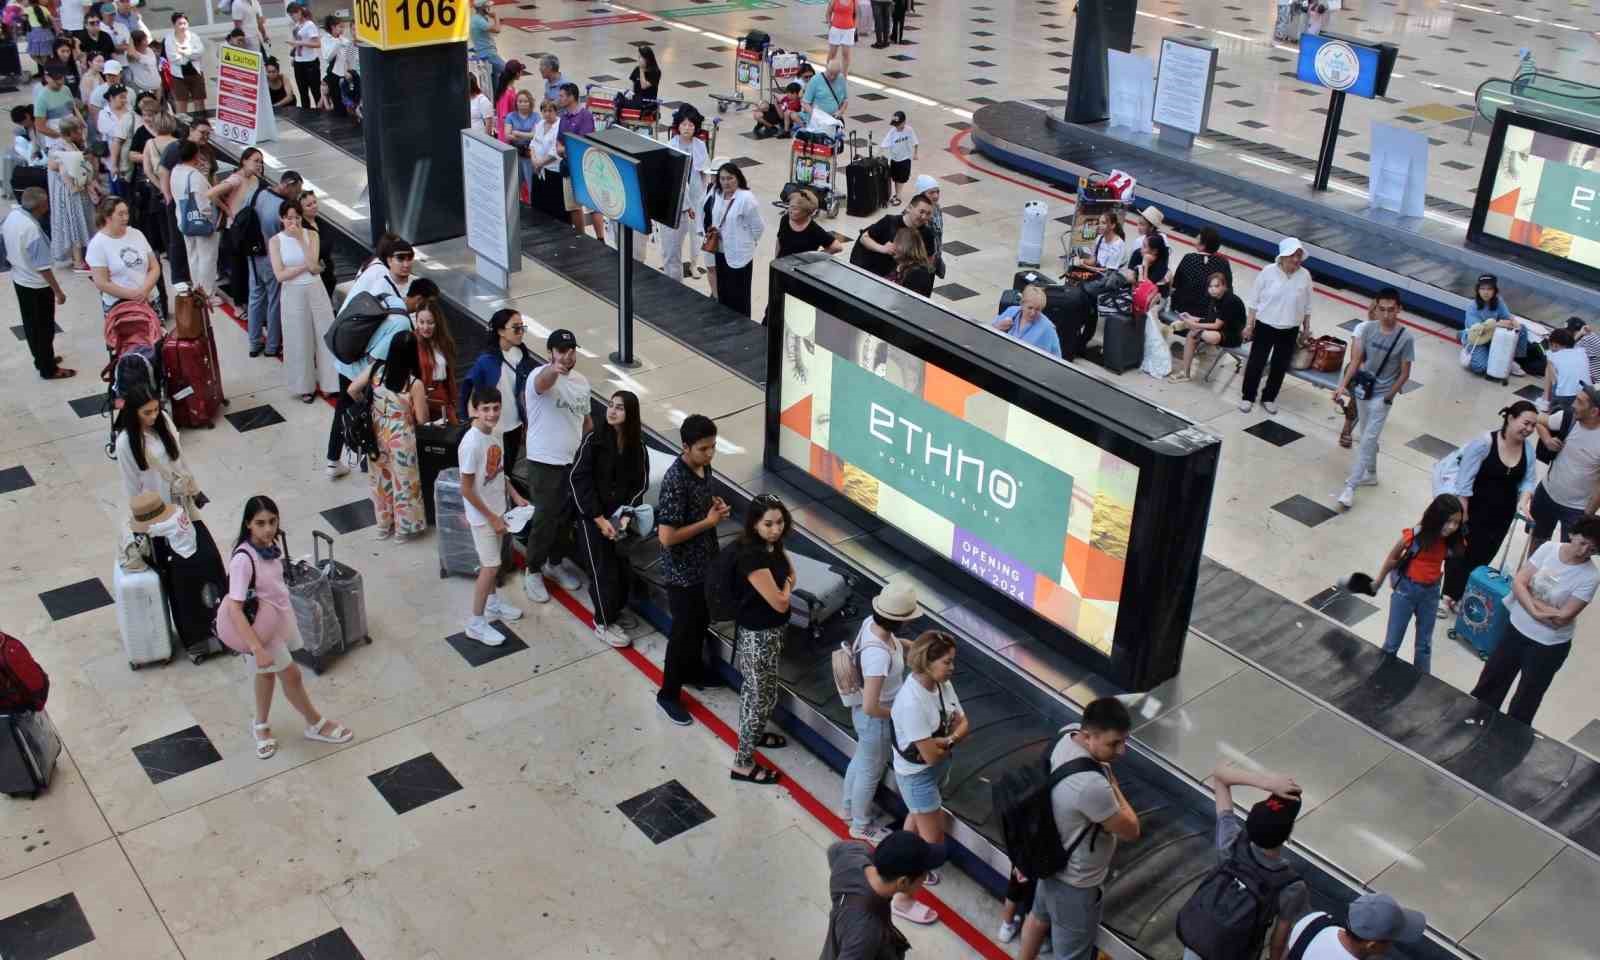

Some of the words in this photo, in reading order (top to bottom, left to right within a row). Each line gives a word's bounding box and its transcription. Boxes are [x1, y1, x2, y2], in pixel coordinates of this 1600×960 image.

[356, 0, 380, 31] 106
[396, 0, 457, 31] 106
[233, 54, 257, 67] CAUTION
[962, 541, 1021, 581] OPENING
[961, 555, 986, 577] MAY
[992, 573, 1025, 601] 2024
